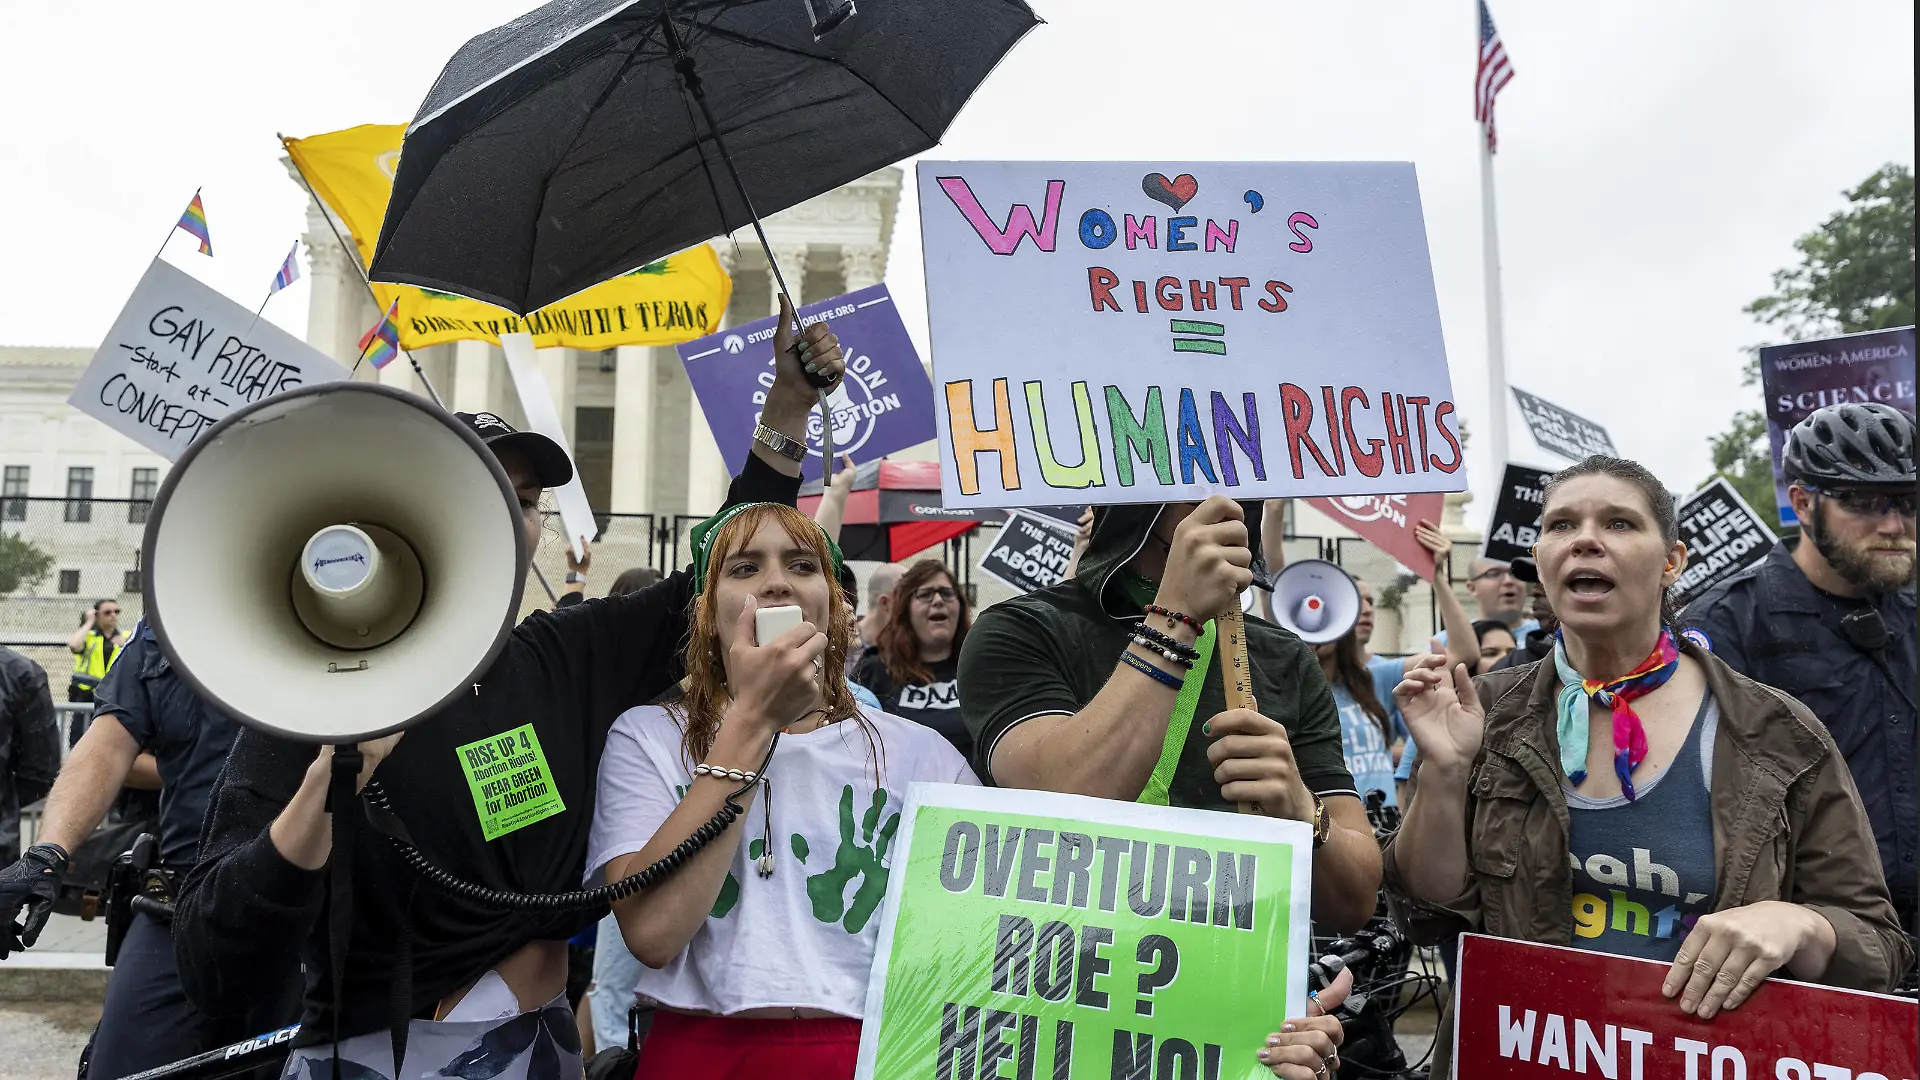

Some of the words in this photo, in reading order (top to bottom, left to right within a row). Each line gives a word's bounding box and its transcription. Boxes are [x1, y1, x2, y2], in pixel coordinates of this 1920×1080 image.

[1088, 266, 1293, 314] RIGHTS
[149, 306, 214, 360] GAY
[1775, 352, 1832, 372] WOMEN
[1839, 344, 1908, 364] AMERICA
[100, 373, 220, 446] CONCEPT
[1777, 380, 1914, 413] SCIENCE
[945, 378, 1266, 495] HUMAN
[1279, 383, 1462, 480] RIGHTS
[1680, 498, 1730, 534] THE
[1686, 507, 1753, 558] -LIFE
[1020, 521, 1046, 542] THE
[1046, 536, 1074, 558] FUT
[1025, 543, 1071, 574] ANT
[992, 544, 1064, 587] ABORT
[1672, 528, 1764, 597] NERATION
[465, 742, 499, 769] RISE
[496, 736, 516, 757] UP
[519, 731, 531, 750] 4
[473, 761, 509, 782] Abortion
[508, 750, 538, 769] Rights!
[481, 777, 511, 800] WEAR
[511, 766, 543, 788] GREEN
[485, 800, 502, 816] for
[504, 781, 549, 809] Abortion
[940, 821, 1257, 932] OVERTURN
[991, 914, 1114, 1010] ROE
[1135, 934, 1180, 1018] ?
[1498, 1005, 1653, 1080] WANT
